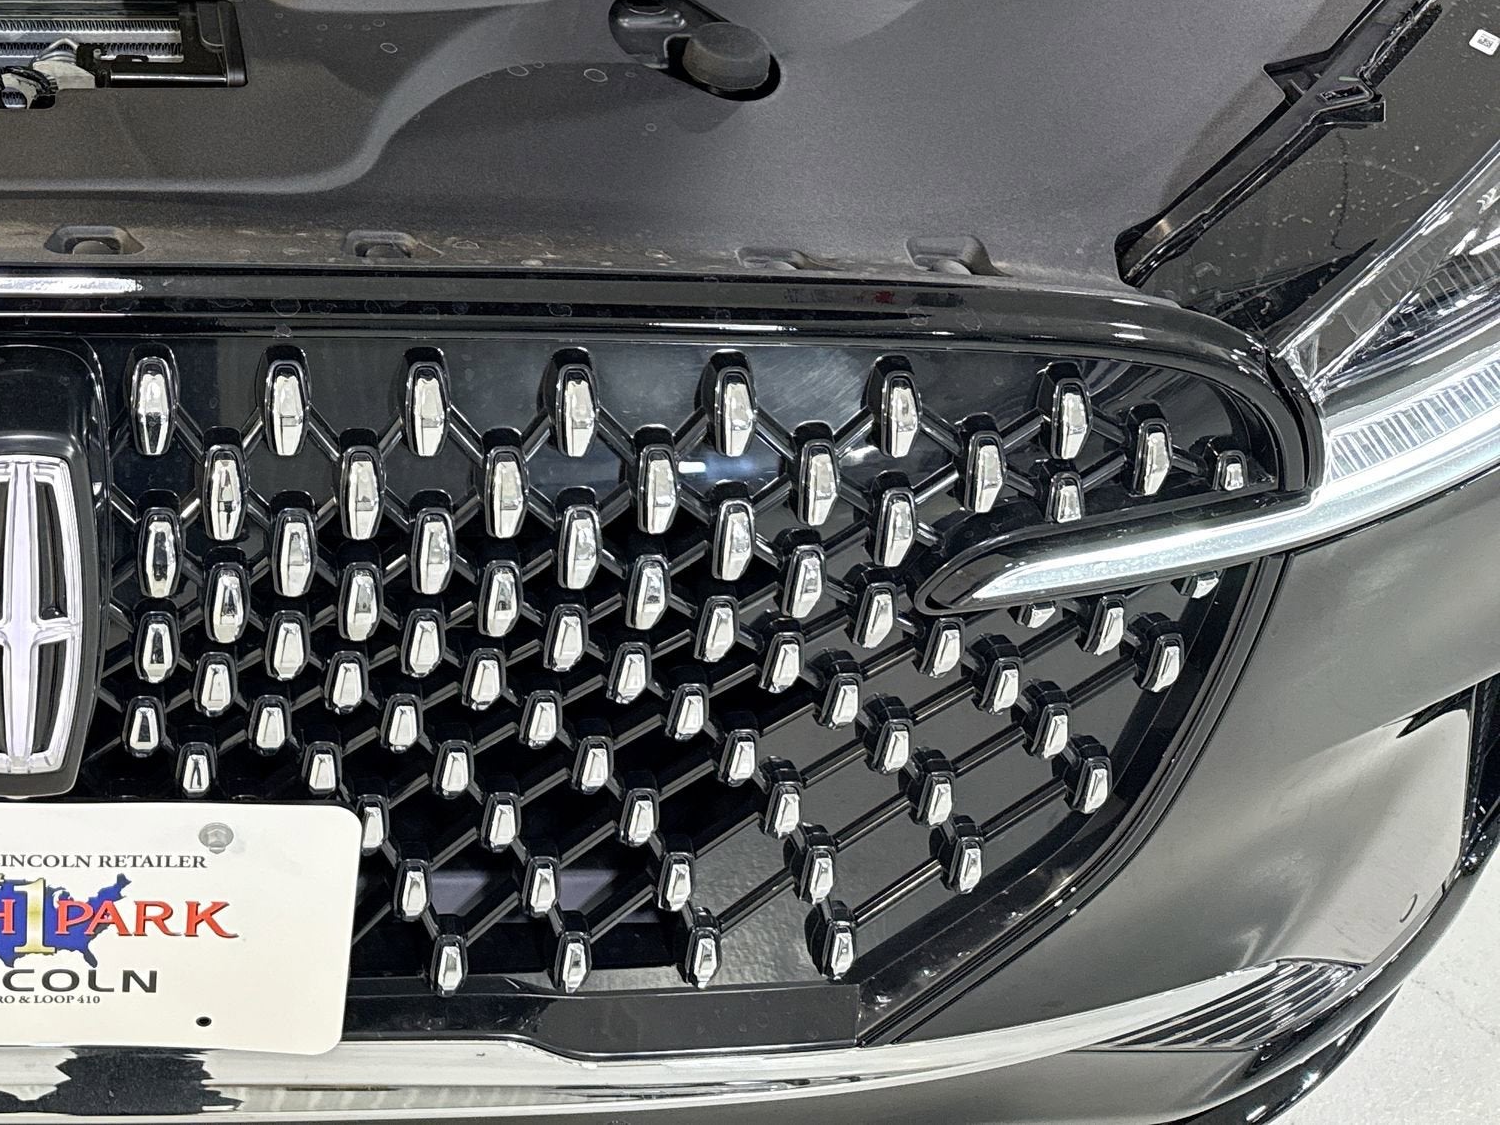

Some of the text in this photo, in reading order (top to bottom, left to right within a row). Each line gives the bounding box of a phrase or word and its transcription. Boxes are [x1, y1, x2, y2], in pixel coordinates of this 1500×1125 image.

[98, 854, 208, 868] RETAILER
[55, 899, 240, 938] PARK
[18, 995, 30, 1004] &
[34, 995, 75, 1004] LOOP
[77, 995, 101, 1005] 410
